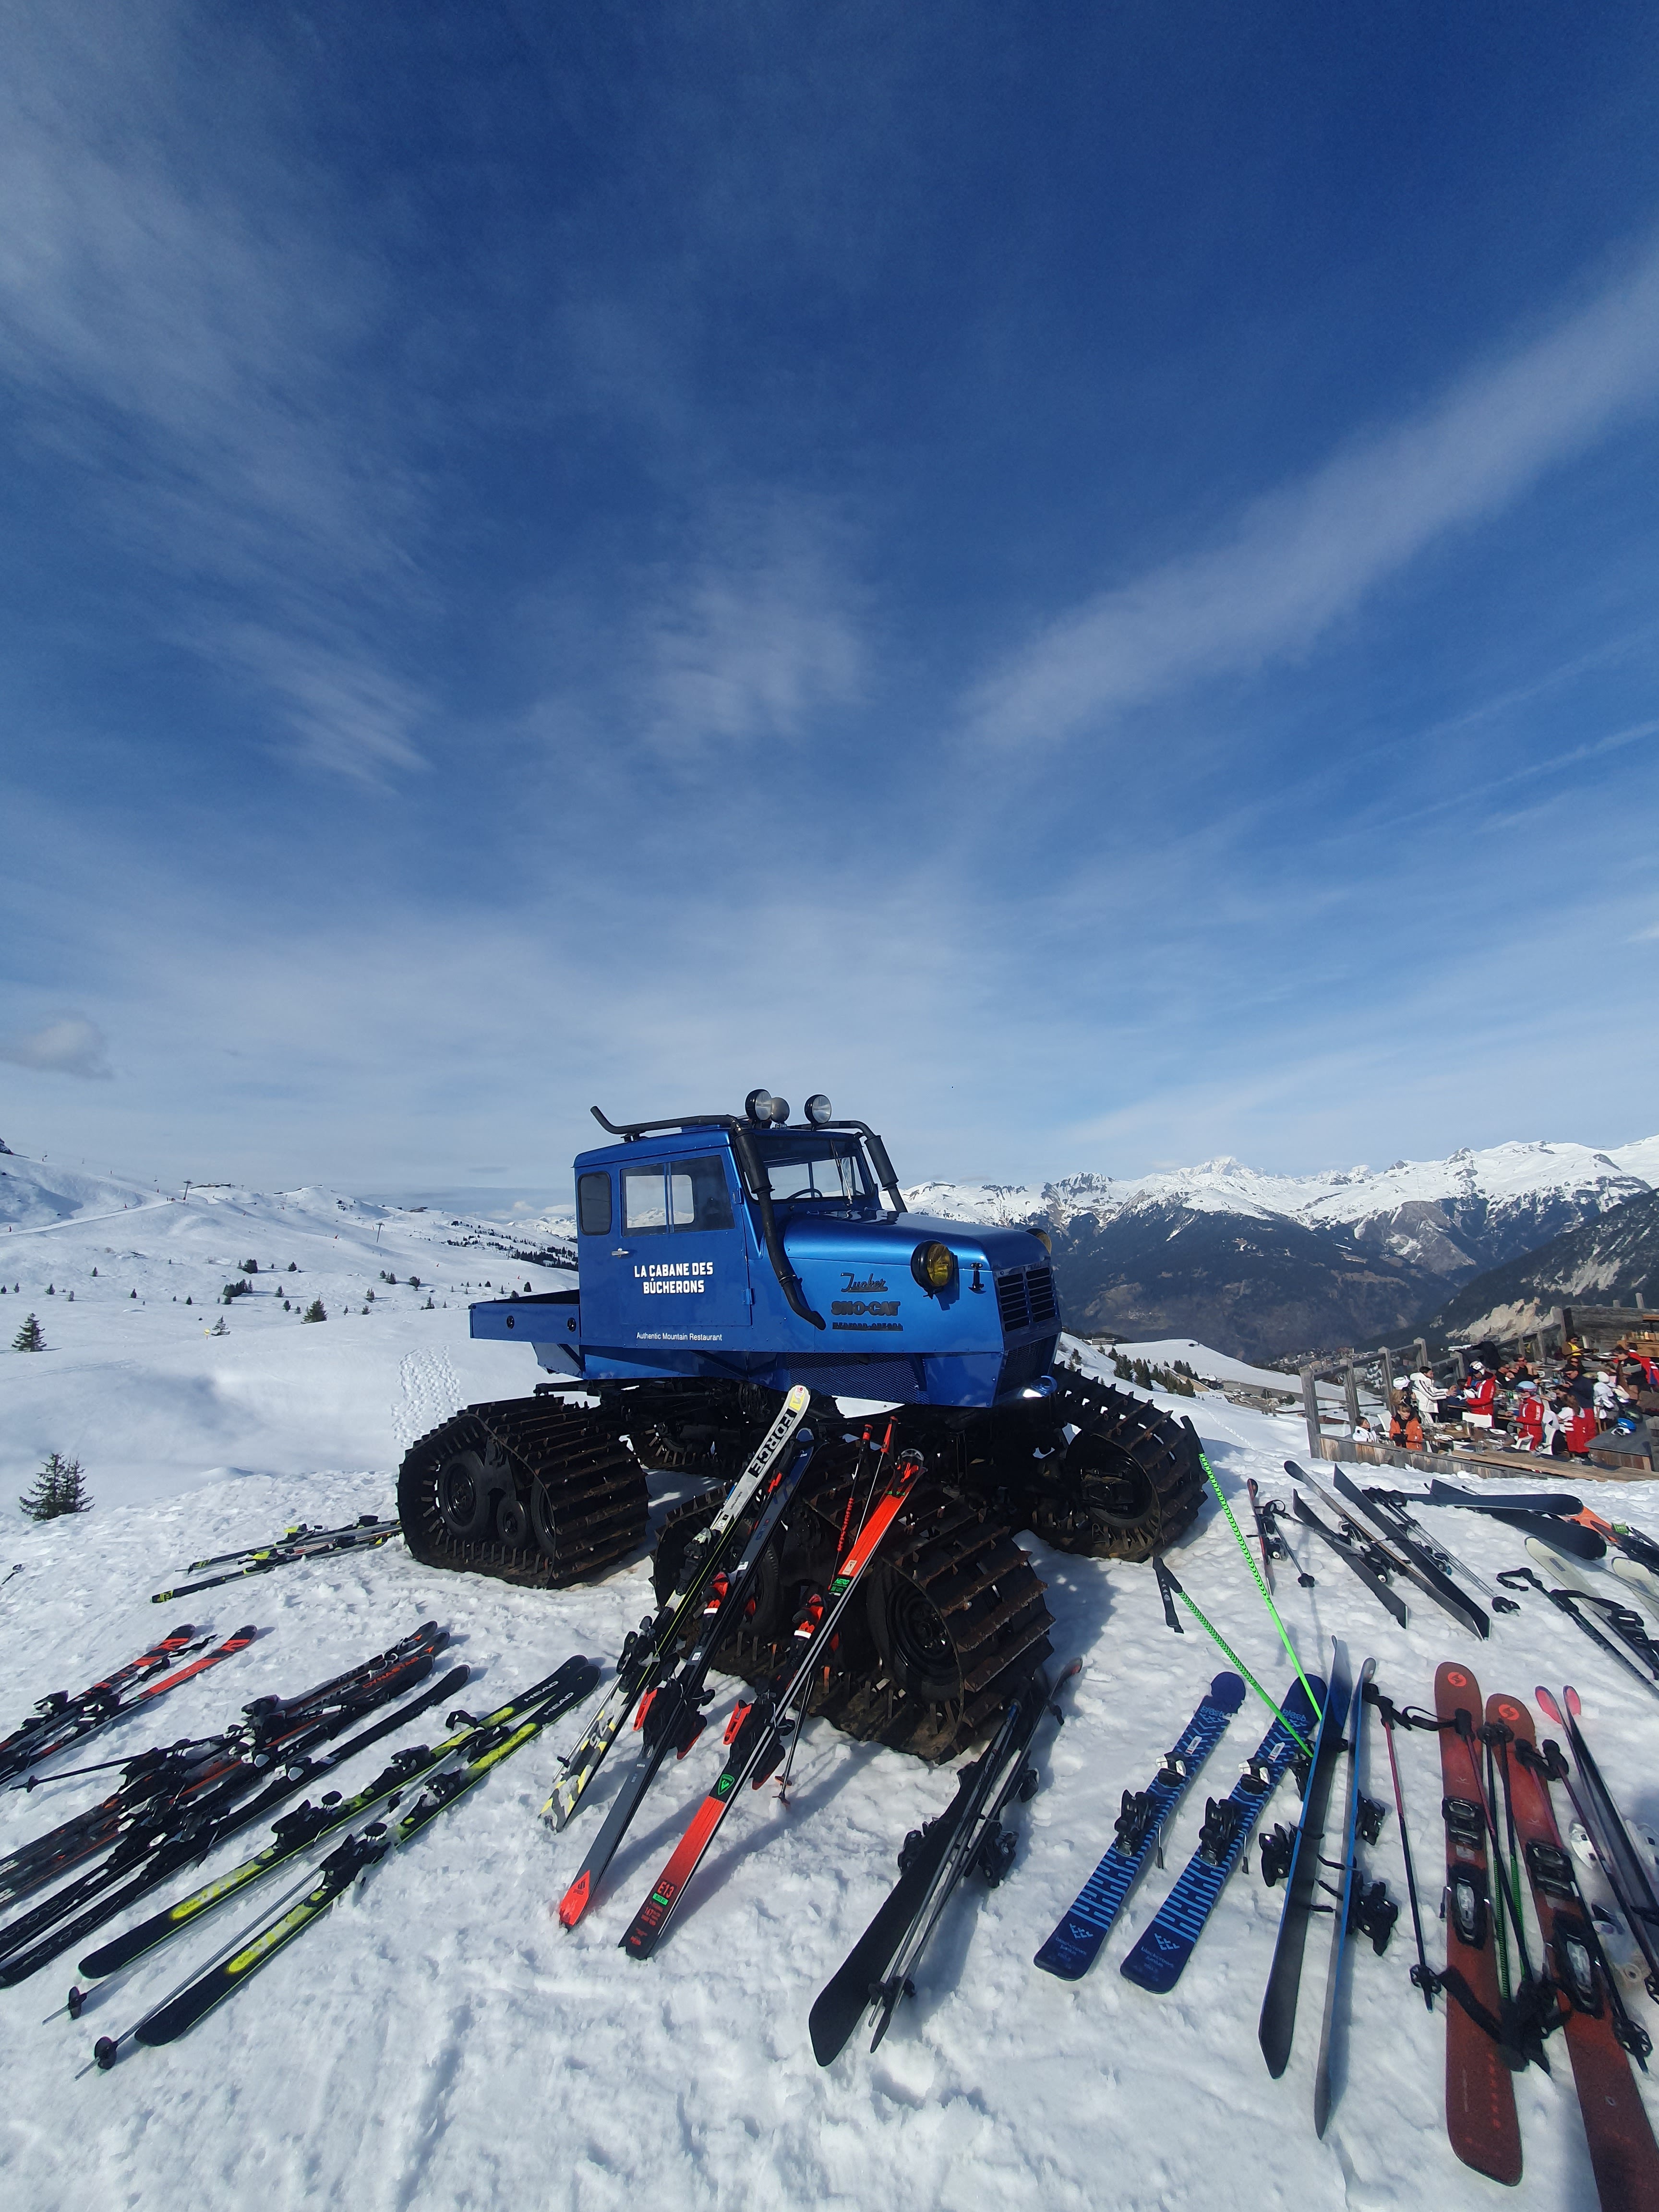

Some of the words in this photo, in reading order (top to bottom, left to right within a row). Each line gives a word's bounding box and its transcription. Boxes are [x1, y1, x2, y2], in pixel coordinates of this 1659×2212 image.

[634, 1265, 647, 1277] LA
[649, 1263, 690, 1277] CABANE
[692, 1262, 713, 1275] DES
[643, 1277, 704, 1294] BÛCHERONS
[841, 1273, 888, 1292] Tucker
[662, 1333, 687, 1341] Mountain
[689, 1333, 722, 1341] Restaurant
[751, 1413, 794, 1474] FORCE
[524, 1681, 559, 1702] HEAD
[543, 1692, 574, 1716] HEAD
